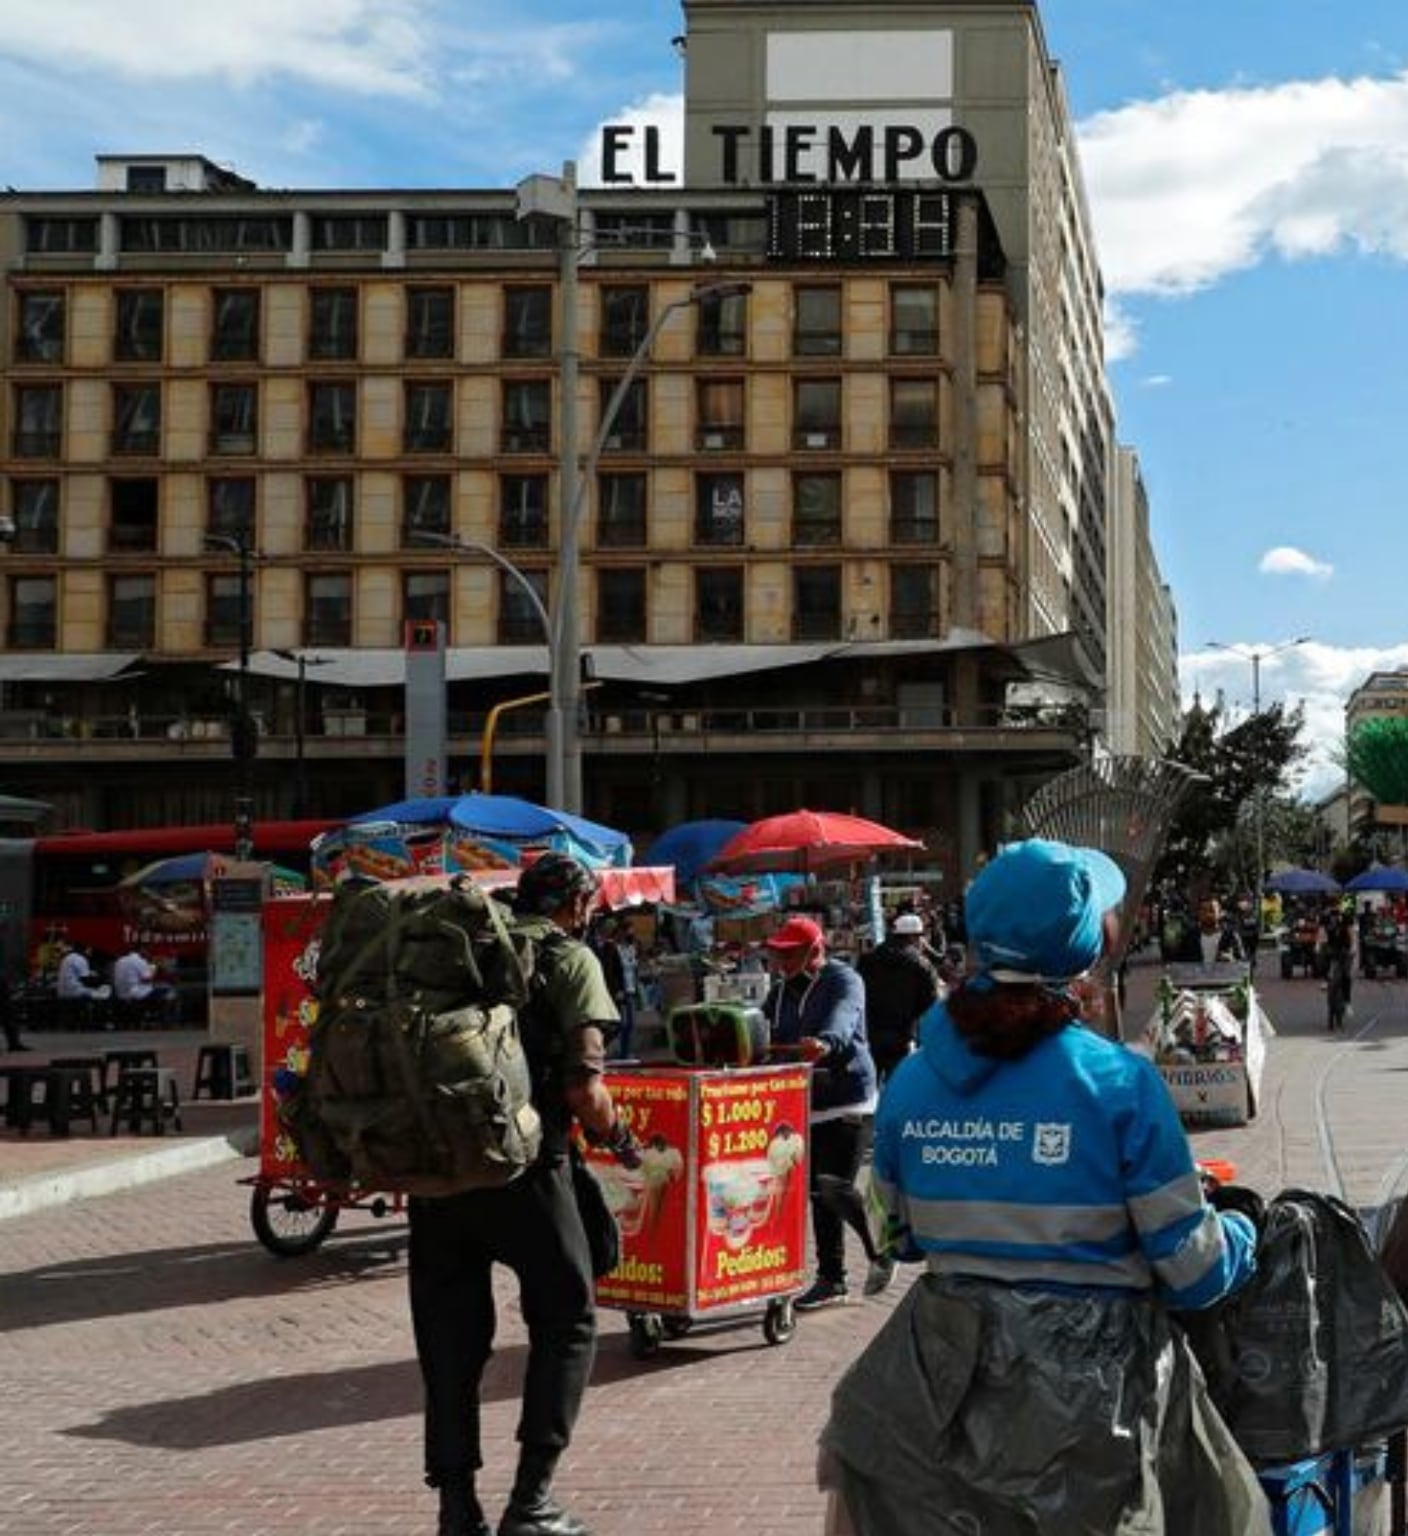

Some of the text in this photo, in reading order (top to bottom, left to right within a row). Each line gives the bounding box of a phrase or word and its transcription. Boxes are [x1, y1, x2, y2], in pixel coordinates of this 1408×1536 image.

[601, 125, 978, 184] EL TIEMPO
[701, 1102, 713, 1127] $
[717, 1099, 762, 1124] 1.000
[708, 1128, 769, 1158] $ 1.200
[902, 1116, 1025, 1141] ALCALDÍA DE
[921, 1142, 999, 1167] BOGOTÁ
[716, 1247, 786, 1279] Pedidos:
